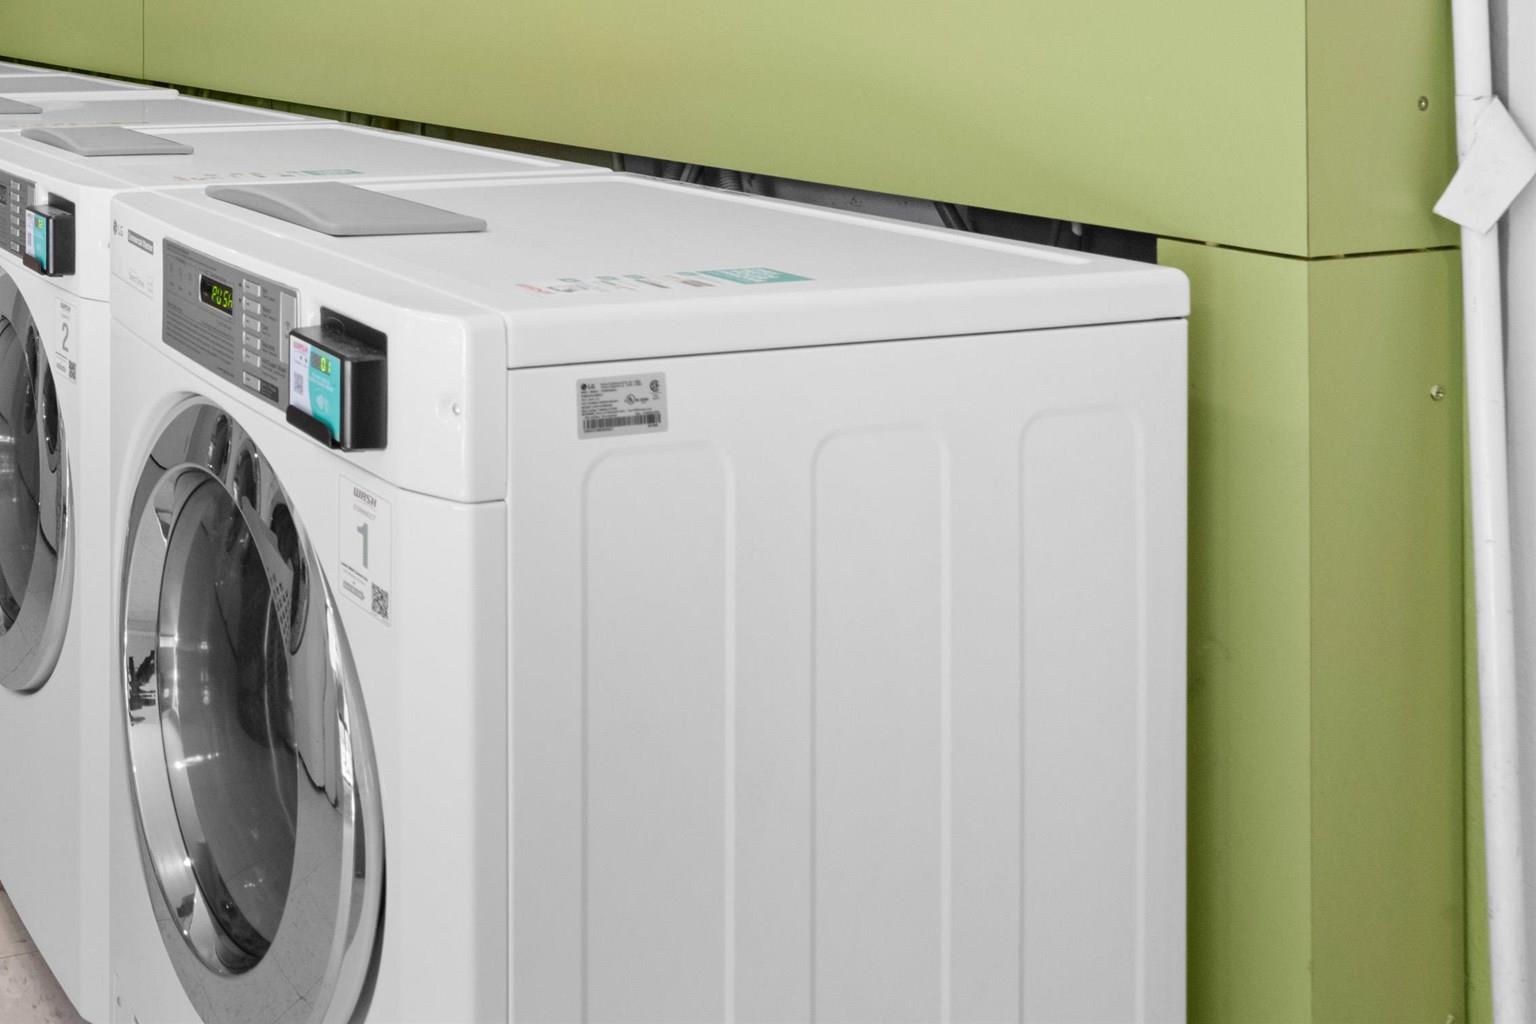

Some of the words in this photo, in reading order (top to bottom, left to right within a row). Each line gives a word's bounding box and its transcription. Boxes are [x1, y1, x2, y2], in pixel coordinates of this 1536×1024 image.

[62, 322, 69, 353] 2
[353, 486, 377, 508] WASH
[356, 522, 369, 569] 1
